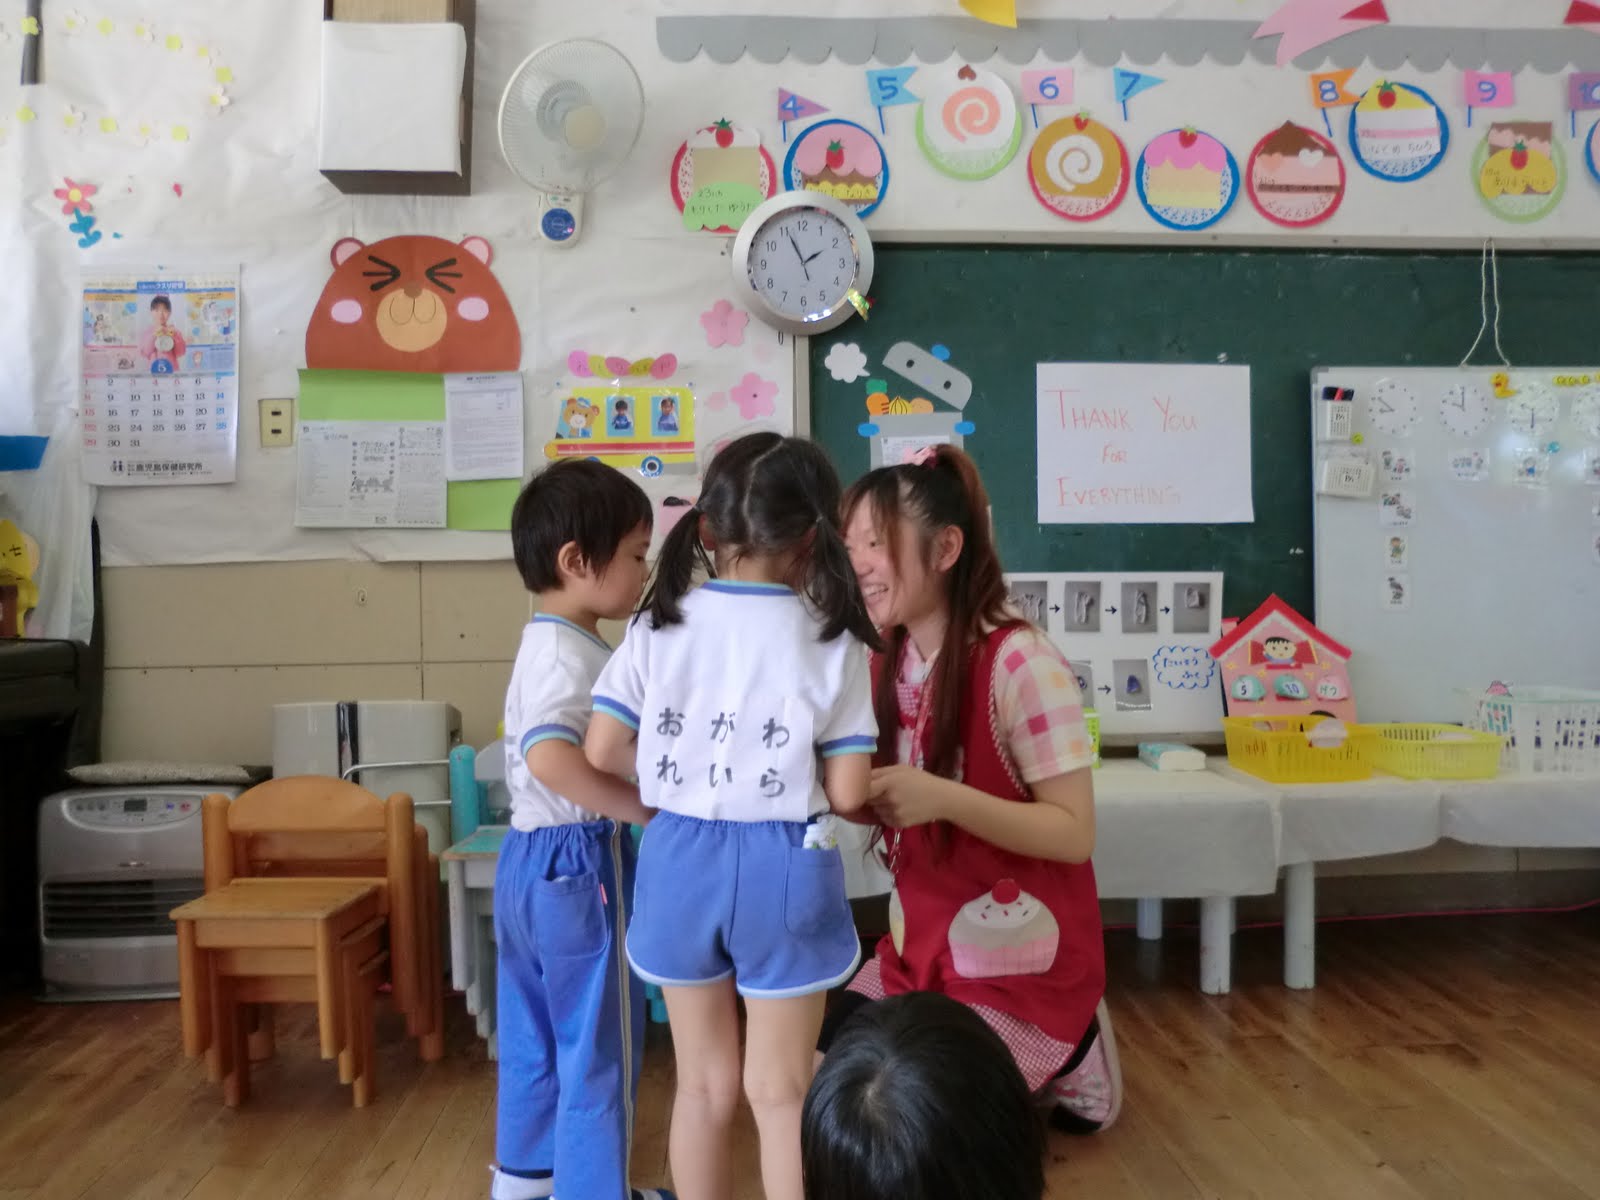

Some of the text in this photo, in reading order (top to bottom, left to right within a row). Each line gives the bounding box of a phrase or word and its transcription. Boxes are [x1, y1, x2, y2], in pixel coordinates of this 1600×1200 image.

[877, 76, 898, 100] 5
[1038, 76, 1059, 100] 6
[1120, 72, 1140, 96] 7
[1318, 80, 1339, 102] 8
[1478, 81, 1497, 102] 9
[781, 94, 805, 119] 4
[779, 226, 789, 237] 11
[797, 219, 808, 232] 12
[818, 225, 823, 236] 1
[765, 240, 777, 252] 10
[831, 236, 839, 249] 2
[760, 258, 768, 271] 9
[838, 257, 846, 270] 3
[766, 277, 774, 290] 8
[833, 275, 840, 287] 4
[781, 290, 788, 303] 7
[800, 295, 807, 307] 6
[819, 289, 826, 302] 5
[157, 363, 167, 373] 5
[1044, 389, 1133, 431] THANK
[108, 424, 120, 432] 23
[131, 424, 142, 432] 24
[216, 422, 226, 430] 28
[1102, 444, 1127, 464] FOR
[1056, 477, 1181, 507] EVERYTHING
[1240, 684, 1248, 696] 5
[1285, 683, 1300, 695] 10
[656, 707, 790, 749] おがわ
[656, 754, 786, 798] れいら
